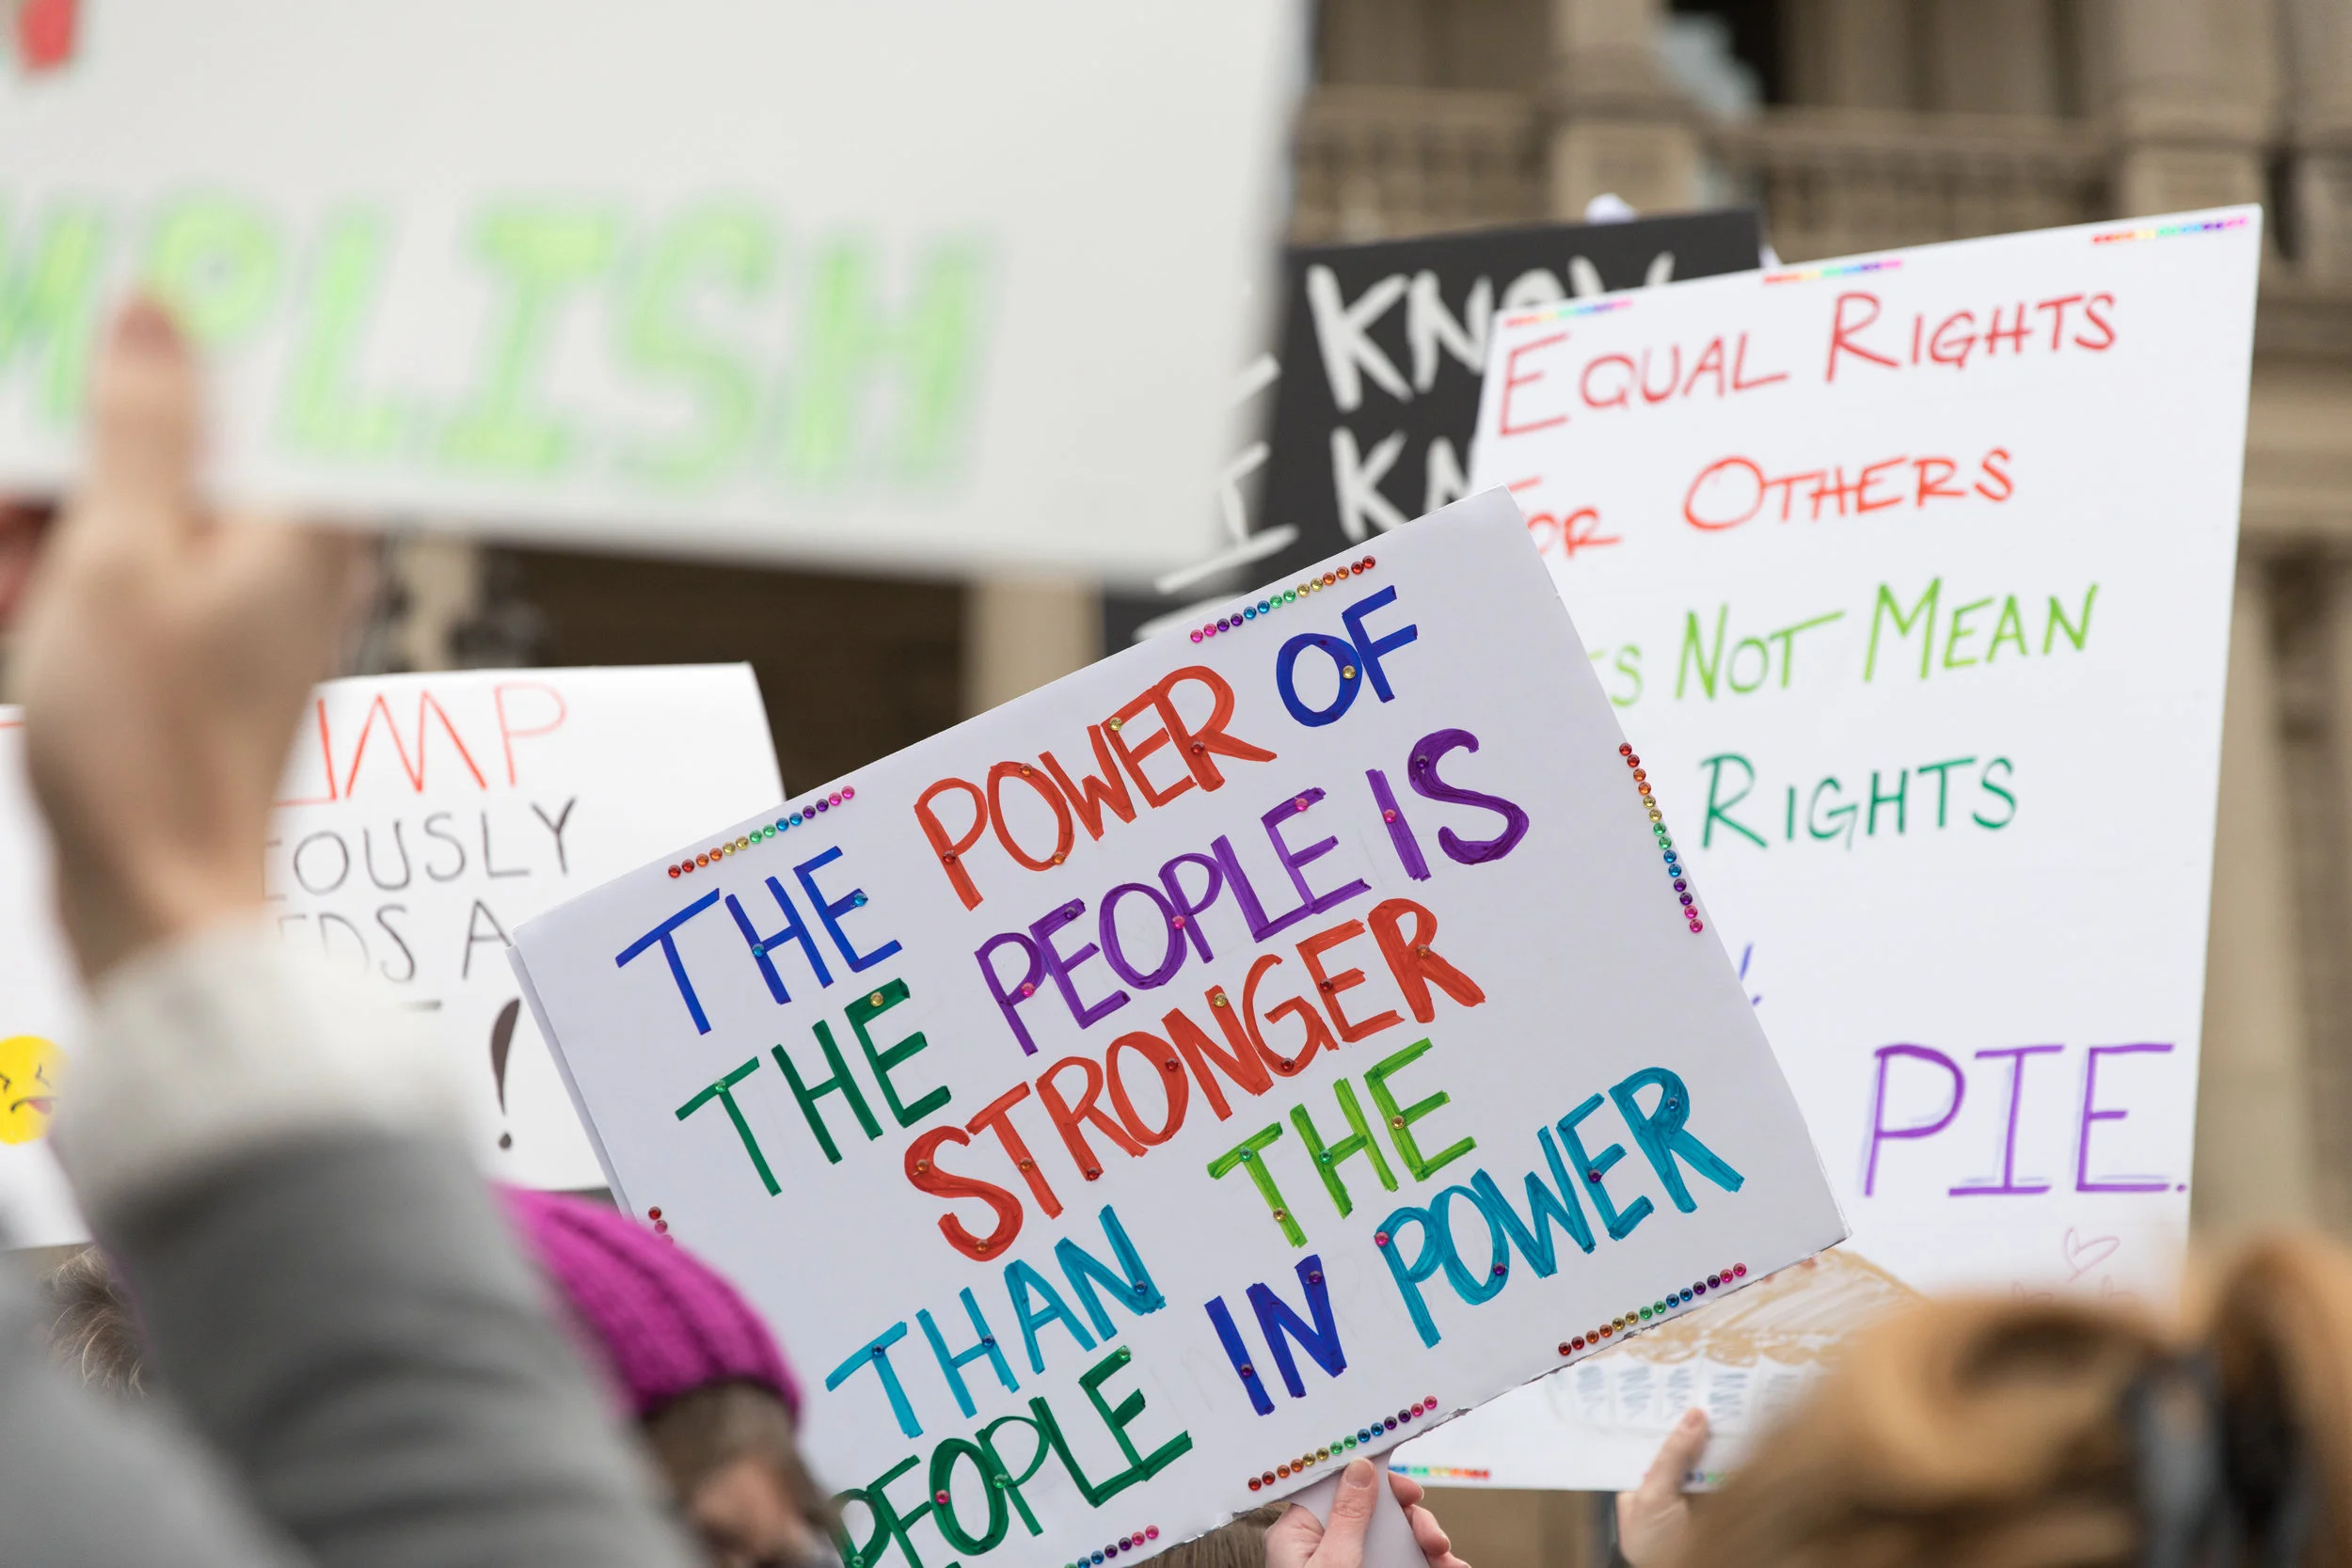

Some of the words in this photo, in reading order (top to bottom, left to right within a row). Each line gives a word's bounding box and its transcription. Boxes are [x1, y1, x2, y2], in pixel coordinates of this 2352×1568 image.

[1498, 332, 1789, 437] EQUAL
[1824, 291, 2117, 383] RIGHTS
[1506, 475, 1623, 559] OR
[1681, 446, 2015, 534] OTHERS
[615, 847, 902, 1035] THE
[914, 666, 1277, 911] POWER
[1276, 585, 1418, 727] OF
[1674, 602, 1846, 701] NOT
[1862, 577, 2100, 683] MEAN
[1700, 752, 2018, 851] RIGHTS
[675, 978, 952, 1196] THE
[974, 787, 1372, 1056] PEOPLE
[1365, 728, 1530, 881] IS
[904, 898, 1486, 1262] STRONGER
[825, 1204, 1167, 1439] THAN
[1207, 1035, 1477, 1248] THE
[1204, 1254, 1347, 1417] IN
[1374, 1067, 1745, 1349] POWER
